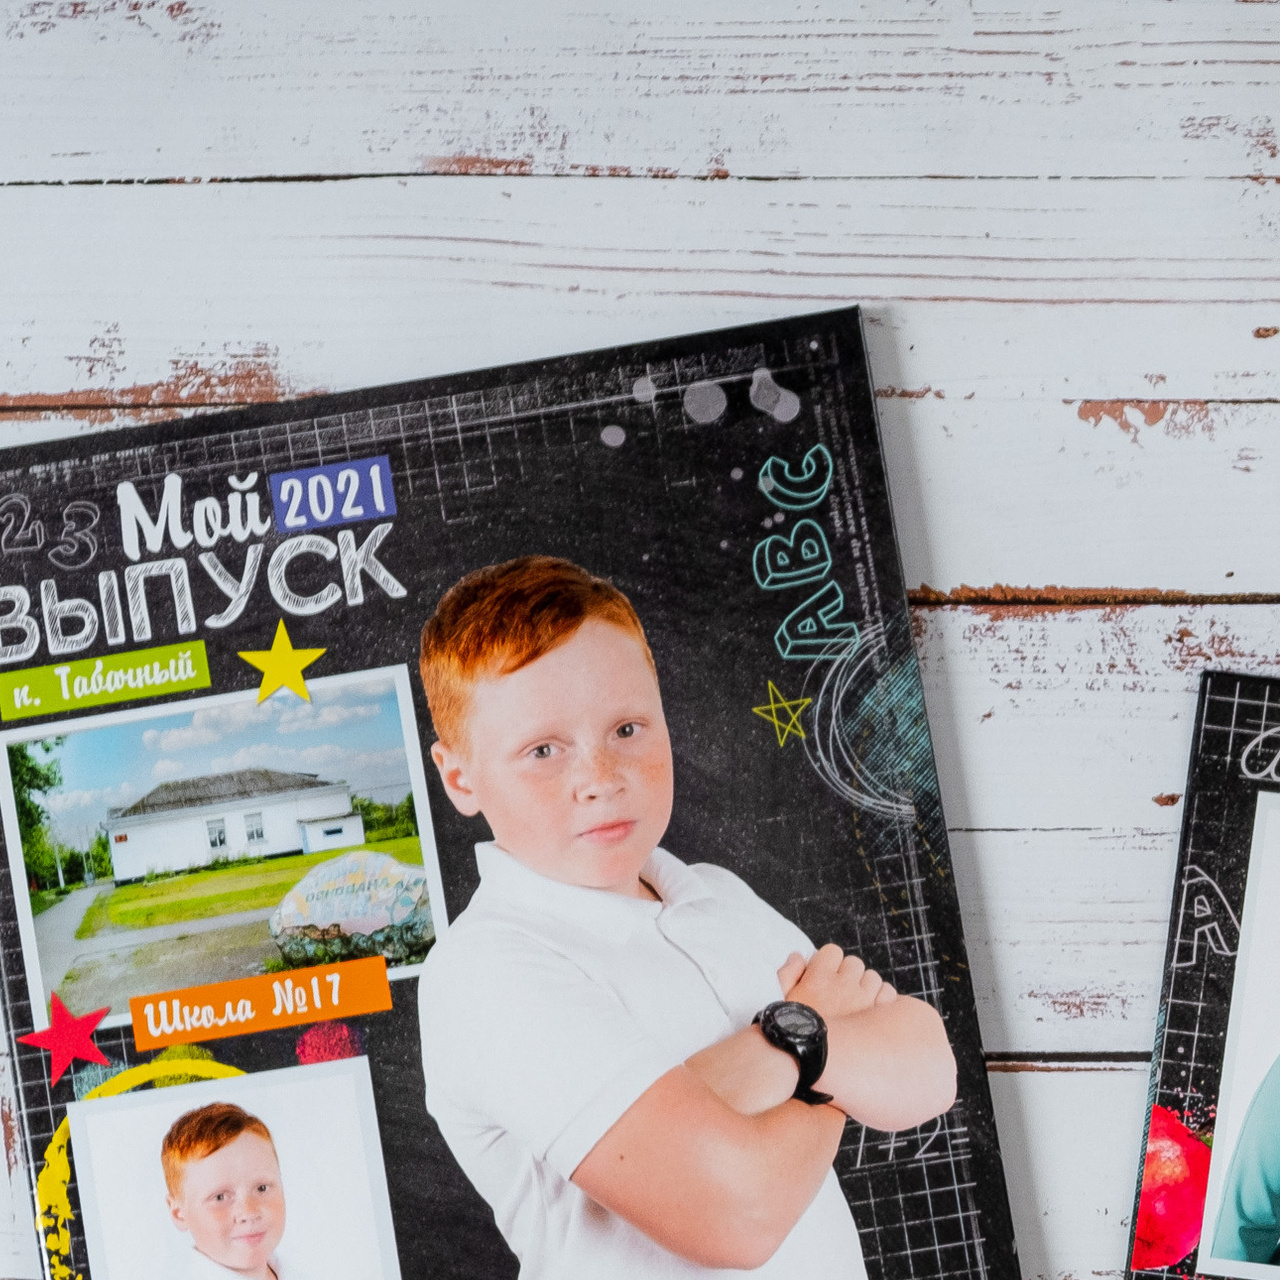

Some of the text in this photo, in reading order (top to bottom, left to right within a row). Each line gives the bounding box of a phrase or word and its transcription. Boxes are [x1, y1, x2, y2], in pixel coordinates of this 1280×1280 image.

[117, 463, 387, 561] Мой 2021
[143, 973, 342, 1037] Школа №17
